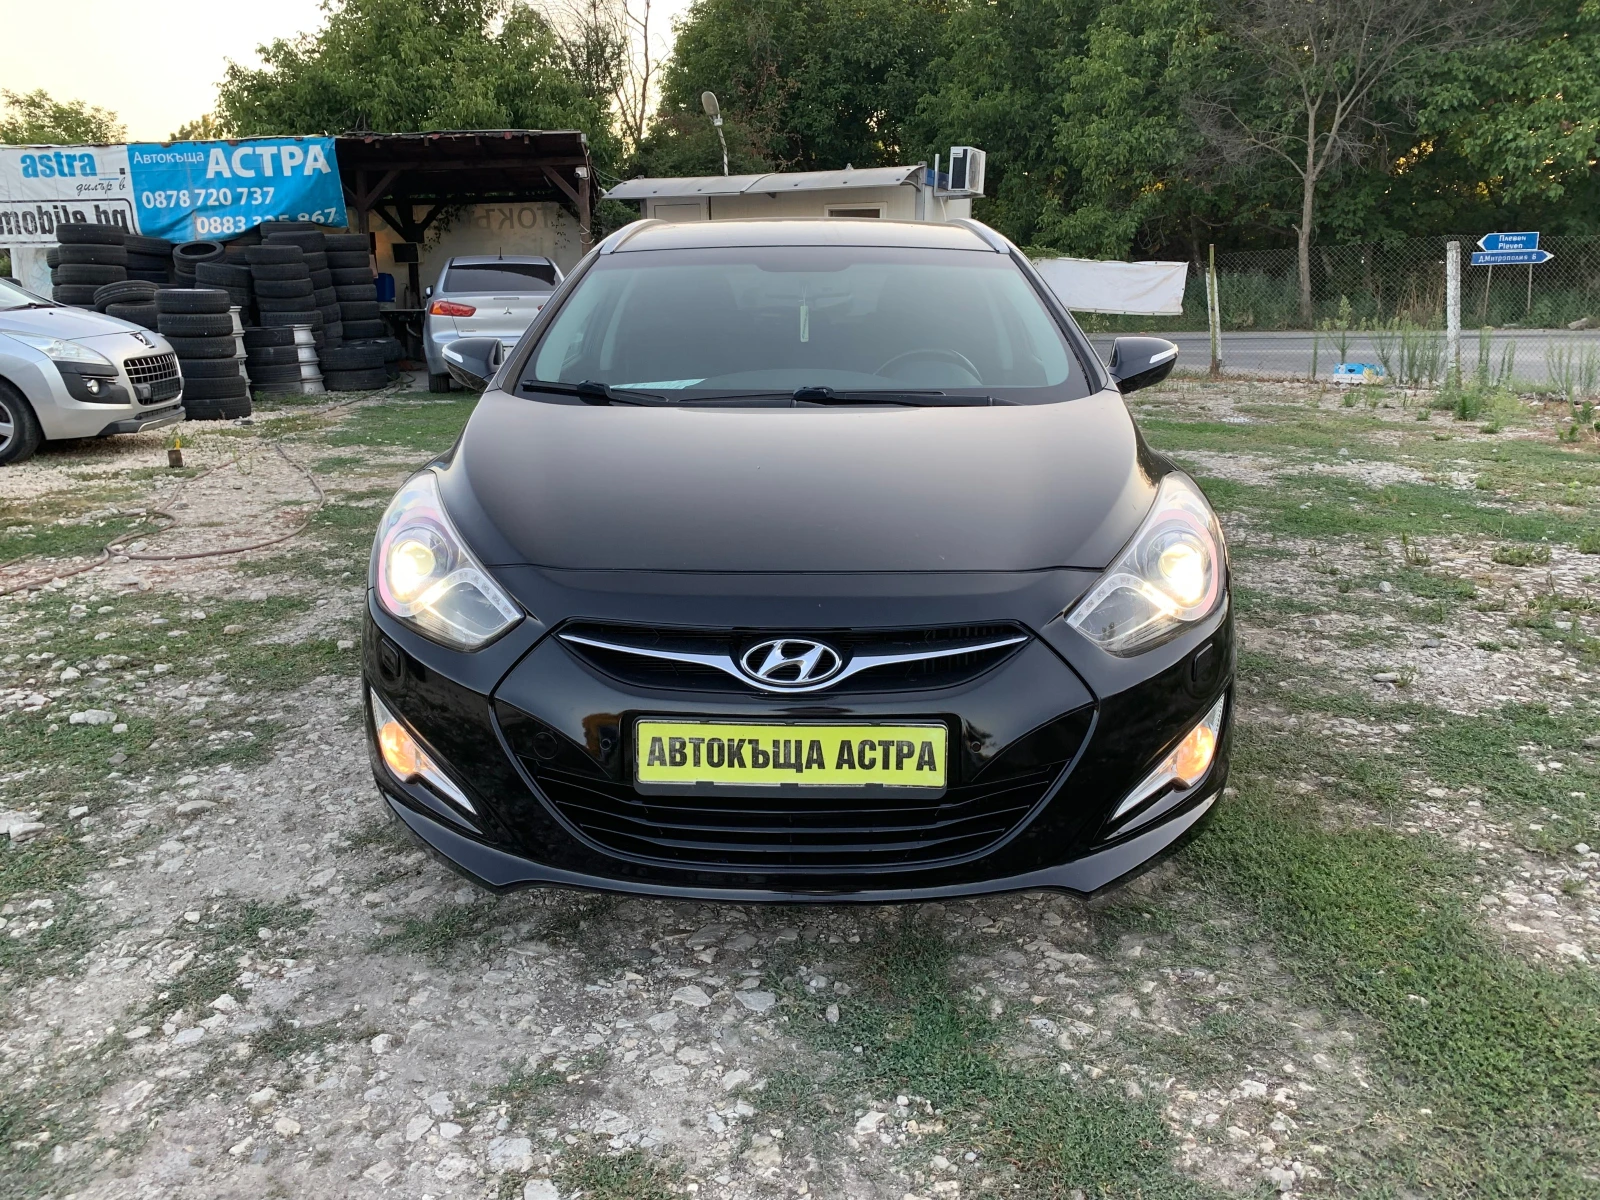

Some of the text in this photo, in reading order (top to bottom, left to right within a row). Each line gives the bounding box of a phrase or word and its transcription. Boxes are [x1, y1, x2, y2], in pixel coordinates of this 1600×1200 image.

[20, 151, 98, 178] astra
[133, 144, 332, 179] Автокъща АСТРА
[141, 187, 275, 209] 0878 720 737
[196, 215, 246, 234] 0883
[1499, 234, 1527, 242] Плевен
[647, 736, 938, 773] АВТОКЪЩА АСТРА
